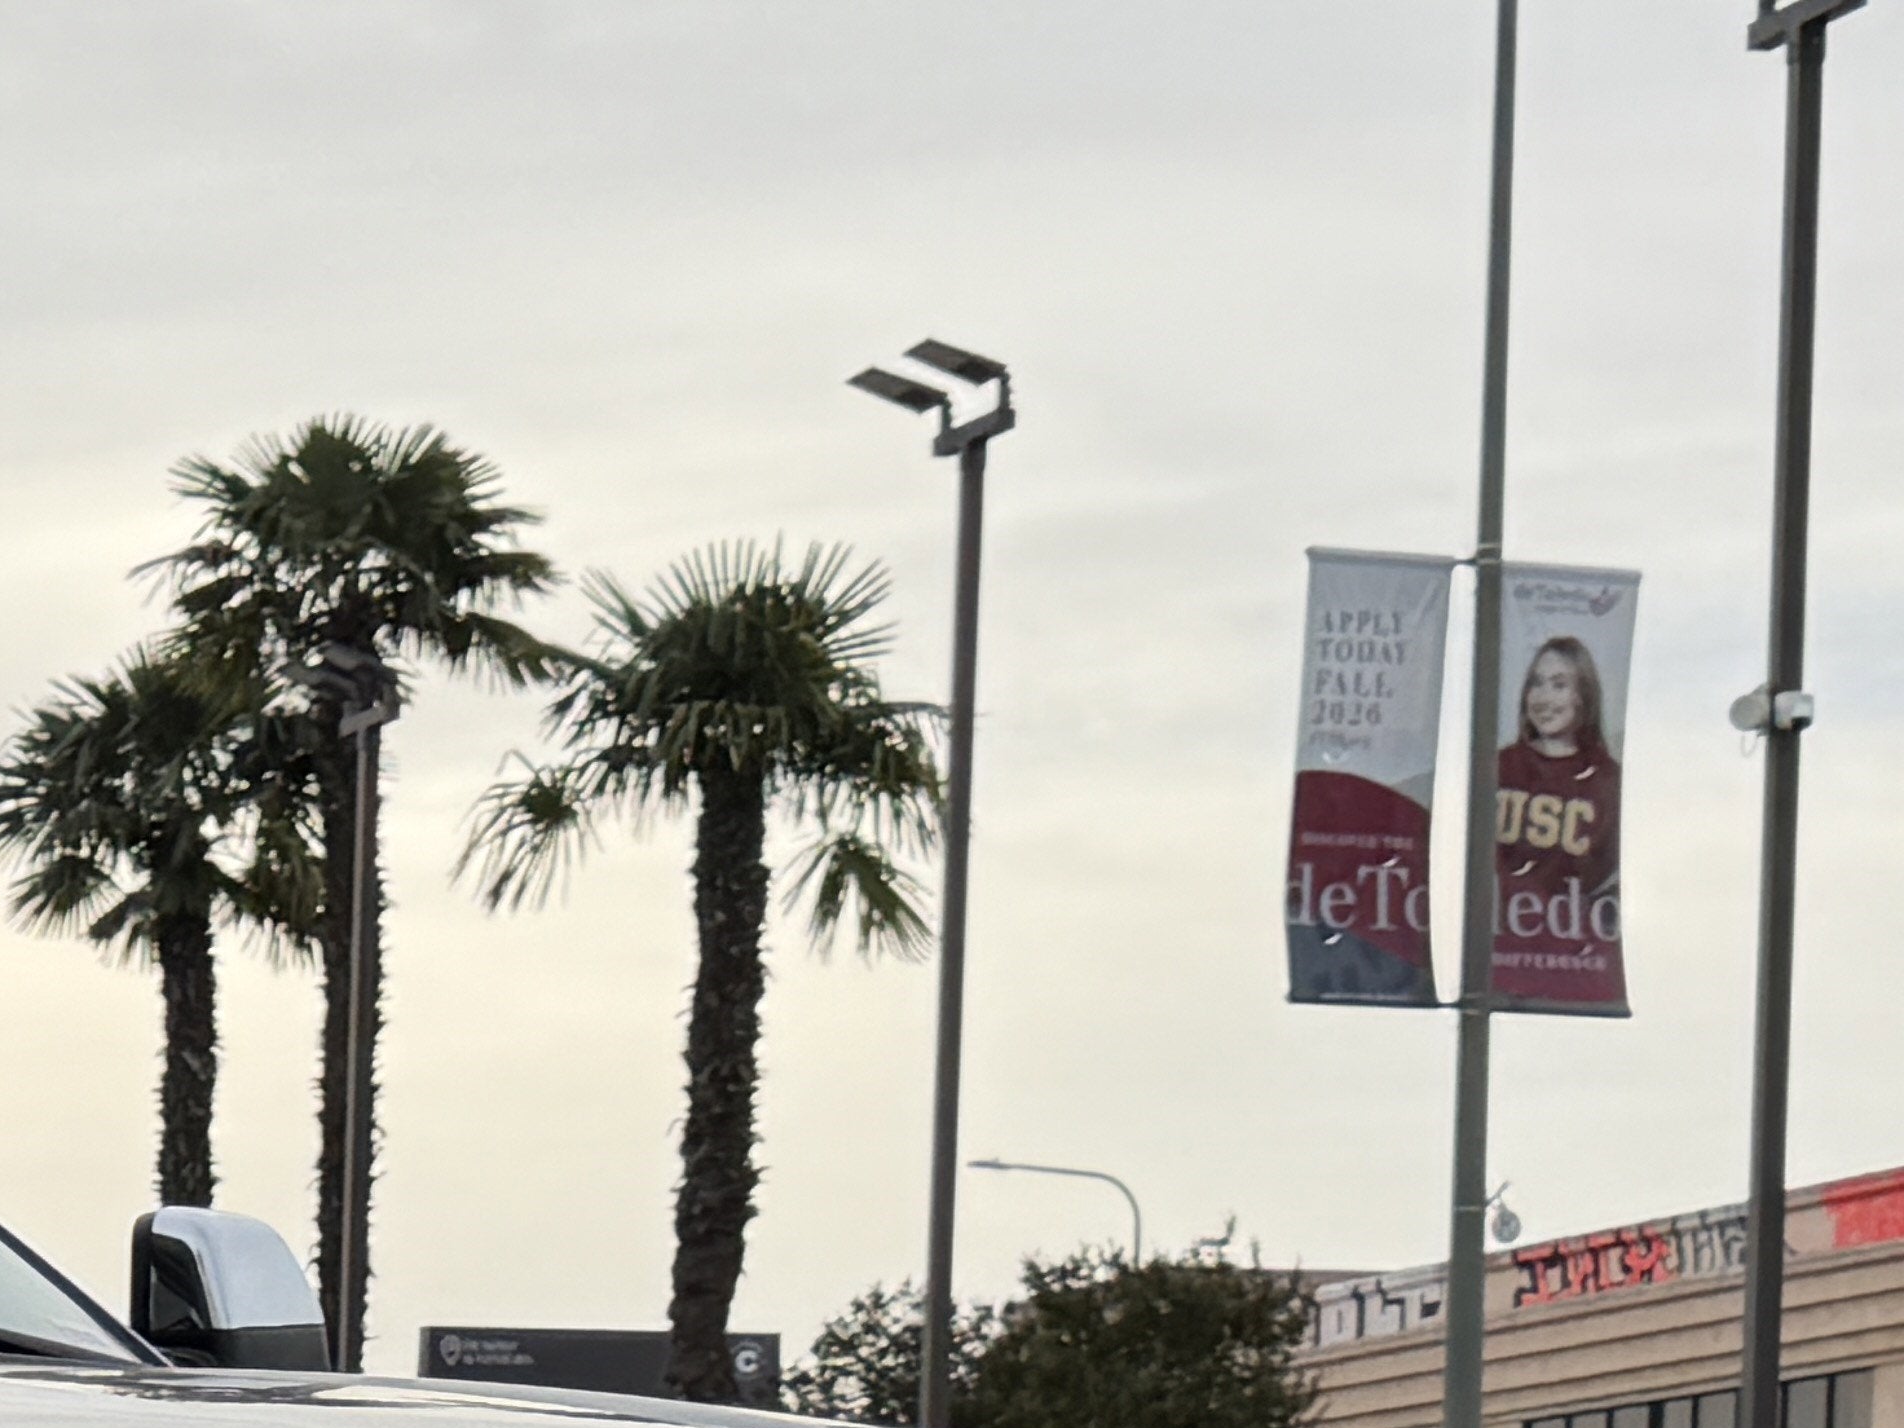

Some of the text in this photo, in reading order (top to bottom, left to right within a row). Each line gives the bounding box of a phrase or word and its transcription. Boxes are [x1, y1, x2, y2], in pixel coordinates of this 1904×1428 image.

[1322, 610, 1402, 637] APPLY
[1318, 638, 1406, 665] TODAY
[1313, 668, 1395, 699] FALL
[1495, 789, 1596, 856] USC
